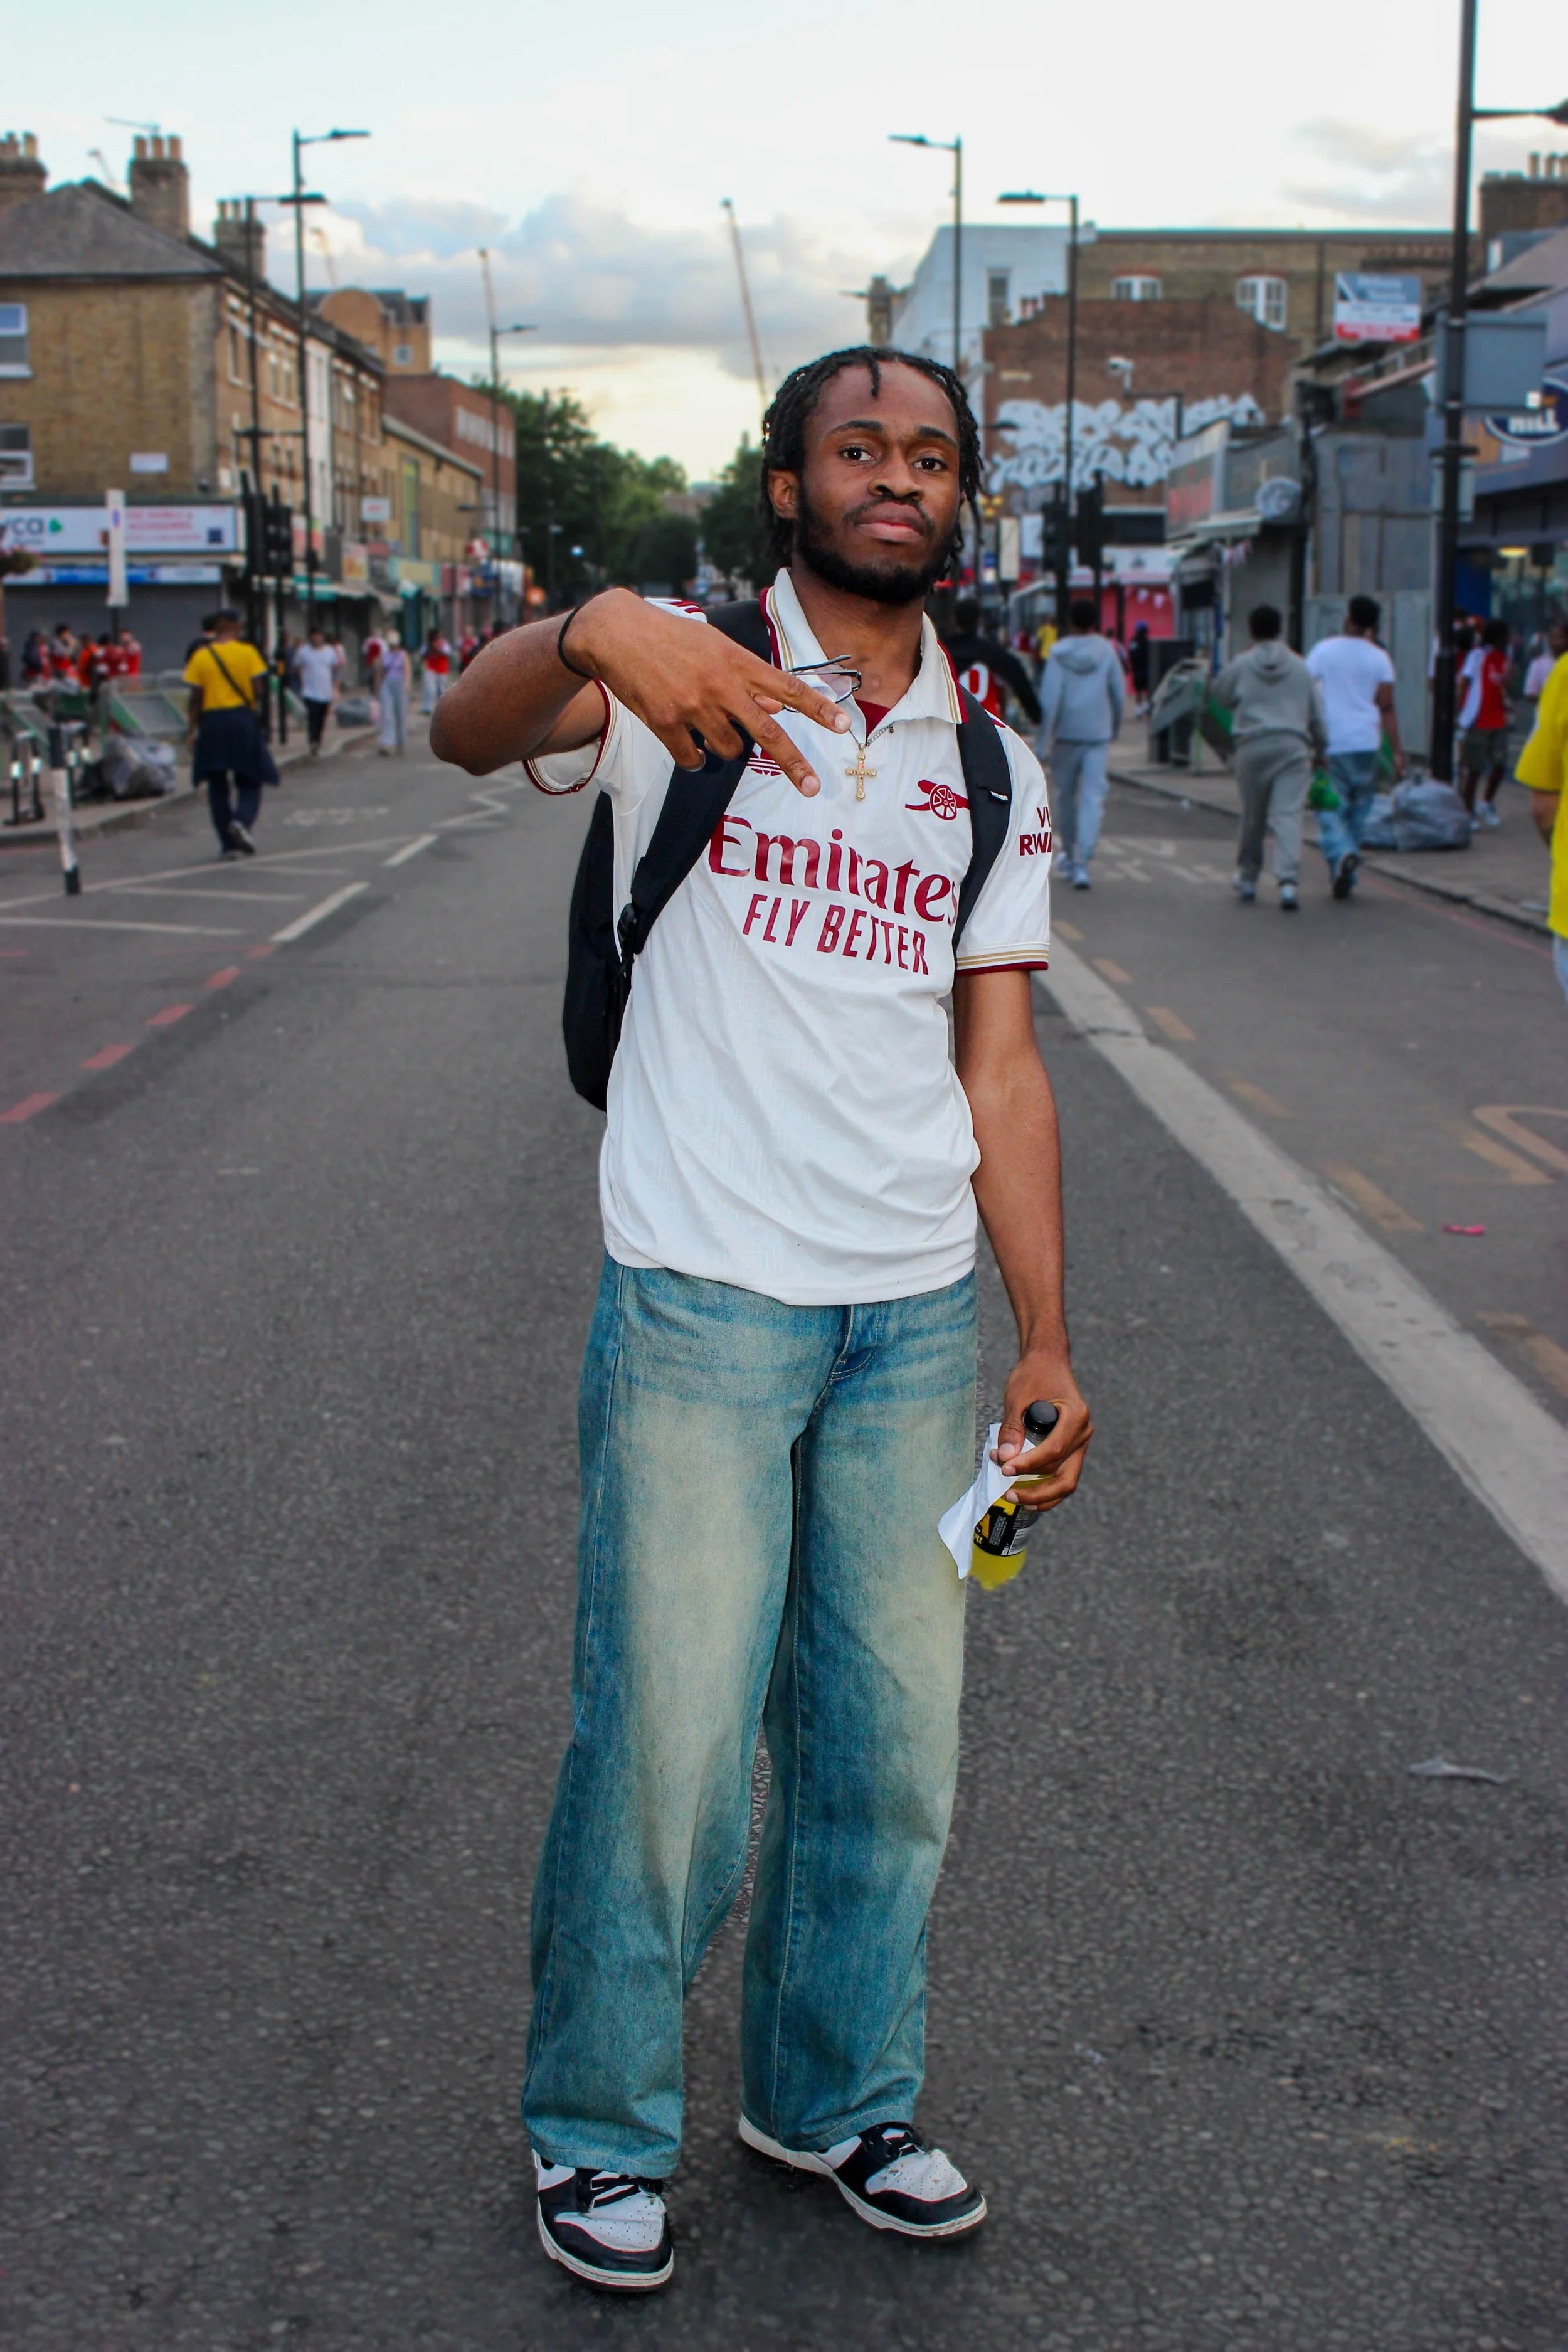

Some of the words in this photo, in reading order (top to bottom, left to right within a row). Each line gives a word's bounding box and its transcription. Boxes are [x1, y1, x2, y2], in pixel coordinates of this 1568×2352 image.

[708, 814, 958, 927] Emirates
[743, 894, 810, 946] FLY
[816, 904, 929, 975] BETTER
